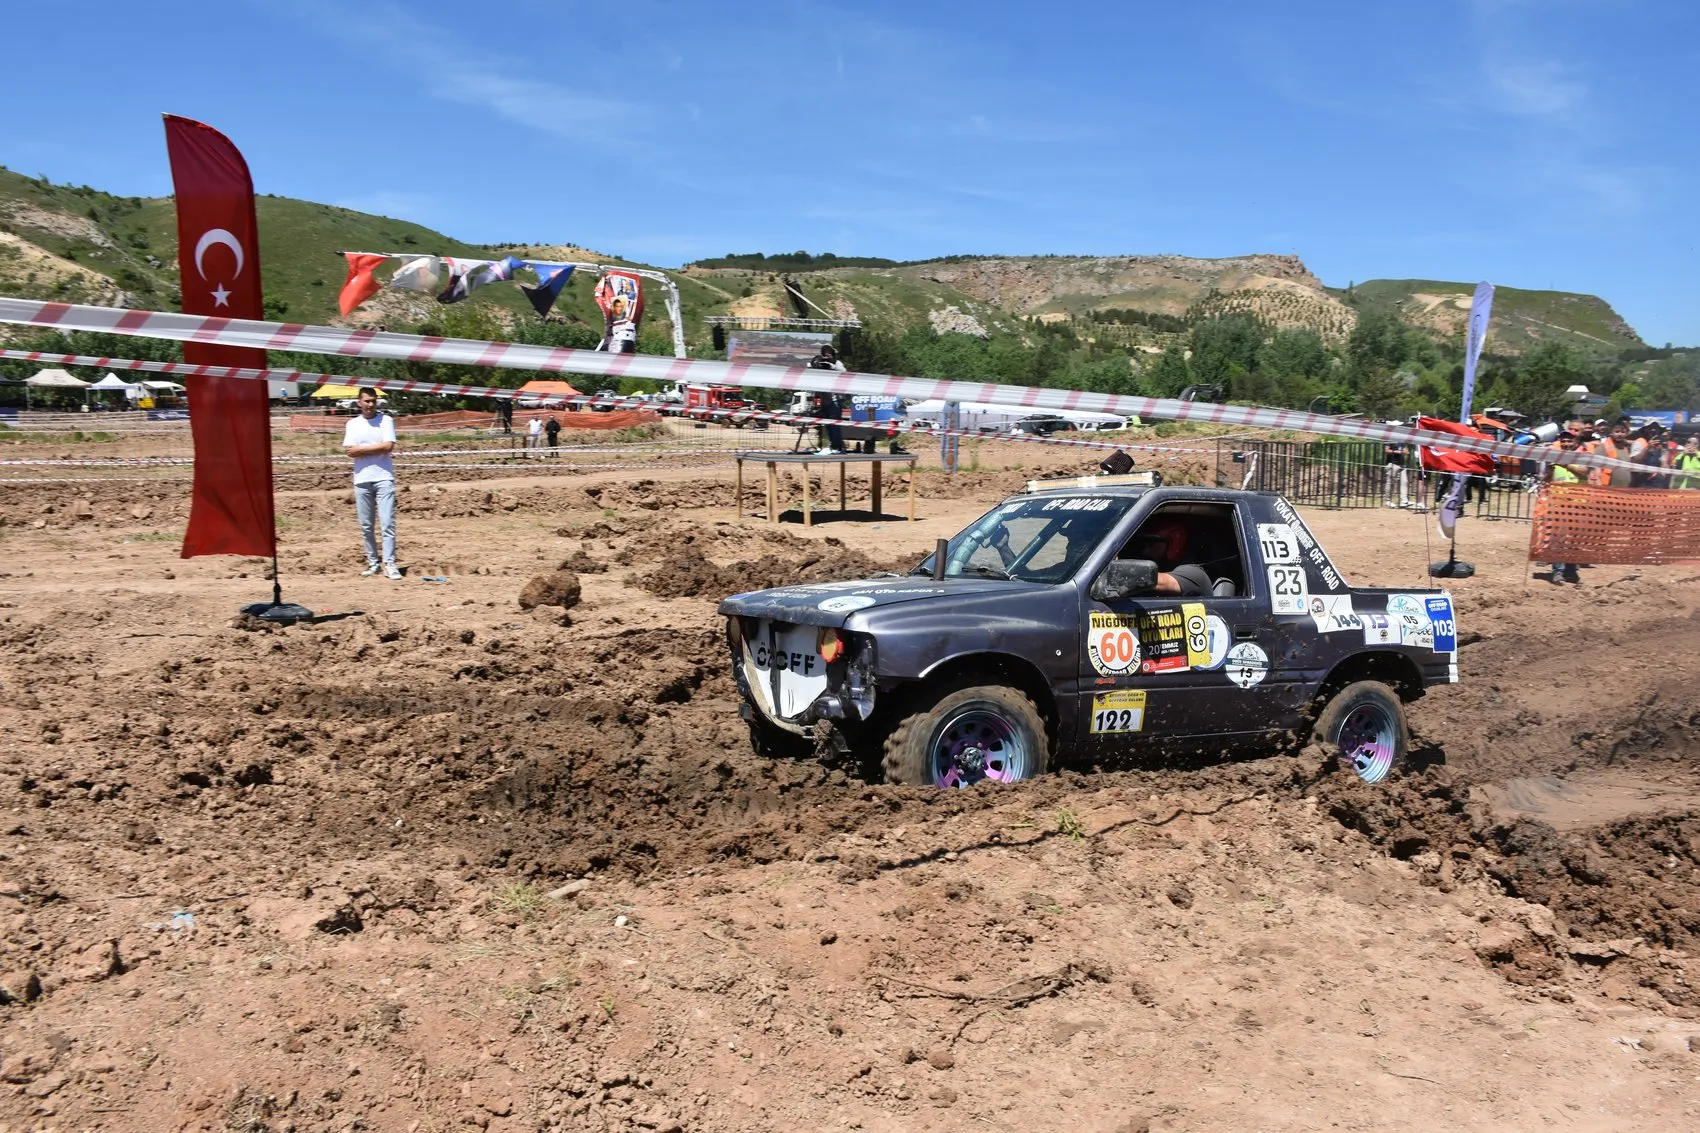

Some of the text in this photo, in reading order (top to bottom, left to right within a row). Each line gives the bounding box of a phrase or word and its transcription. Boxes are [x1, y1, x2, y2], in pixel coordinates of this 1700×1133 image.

[1262, 541, 1290, 558] 113
[1273, 498, 1297, 526] TOKAT
[1309, 548, 1325, 565] OFF
[1321, 566, 1340, 590] ROAD
[1274, 569, 1302, 596] 23
[1157, 613, 1182, 627] ROAD
[1331, 614, 1361, 628] 144
[1403, 615, 1418, 625] 05
[1433, 619, 1454, 637] 103
[1188, 616, 1207, 652] 60
[1101, 631, 1133, 663] 60
[1240, 668, 1253, 678] 15
[1095, 709, 1132, 731] 122
